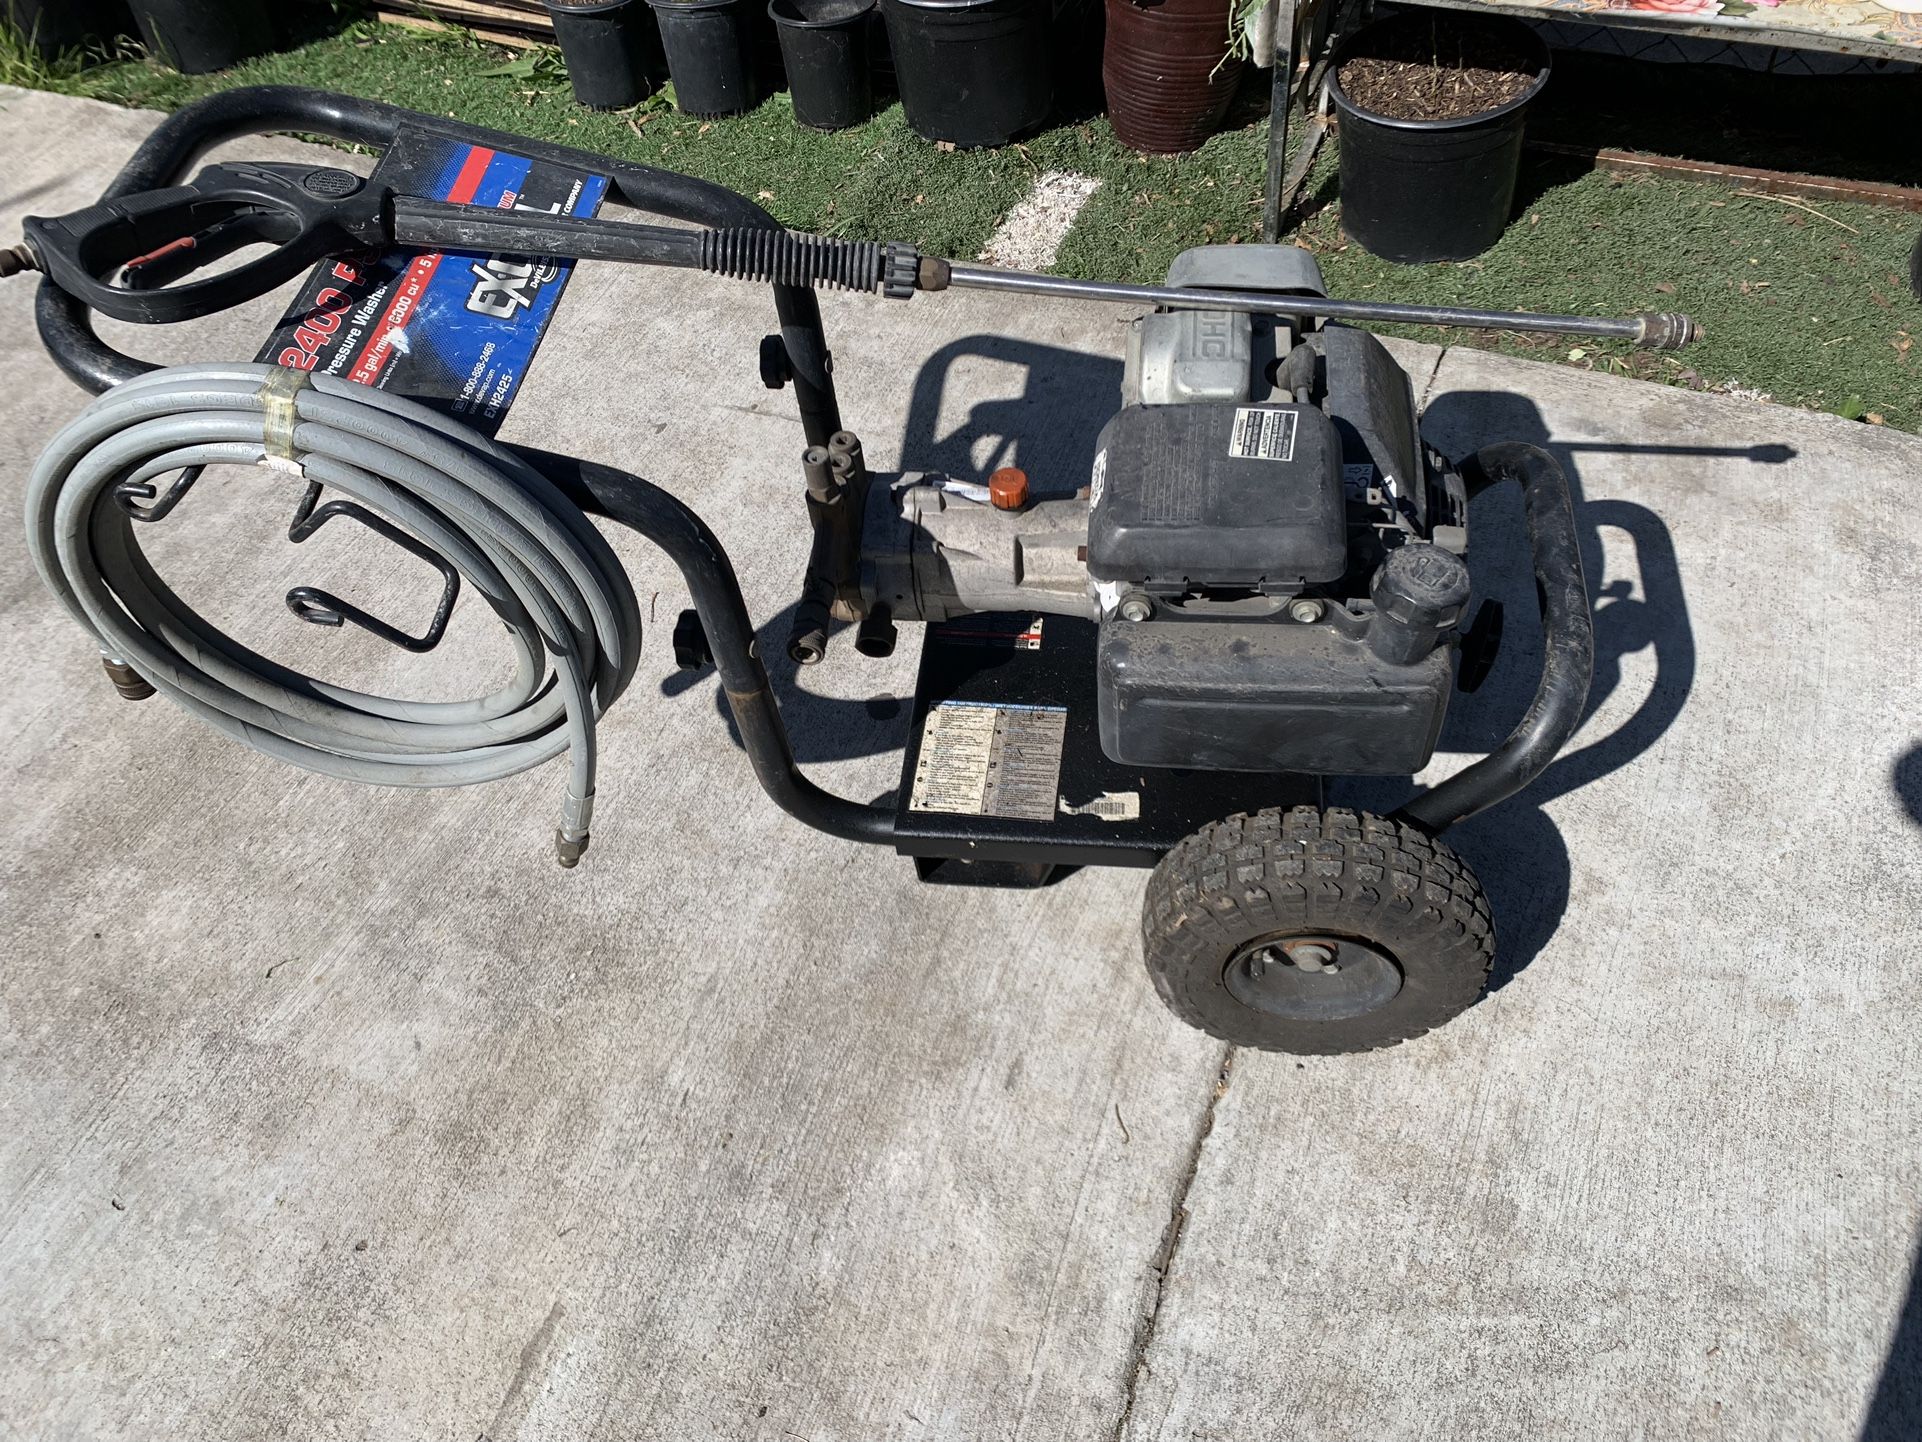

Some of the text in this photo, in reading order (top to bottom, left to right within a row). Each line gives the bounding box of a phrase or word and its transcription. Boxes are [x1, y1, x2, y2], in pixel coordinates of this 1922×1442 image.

[563, 178, 583, 214] COMPANY
[419, 258, 433, 269] 5
[351, 281, 388, 326] Washer
[278, 286, 354, 371] 2400
[460, 341, 496, 401] 1-800-888-2468
[469, 368, 496, 415] www.devap.com
[484, 373, 513, 419] EXH2425
[1235, 418, 1245, 441] WARNING
[1261, 415, 1271, 449] ADVERTENCIA
